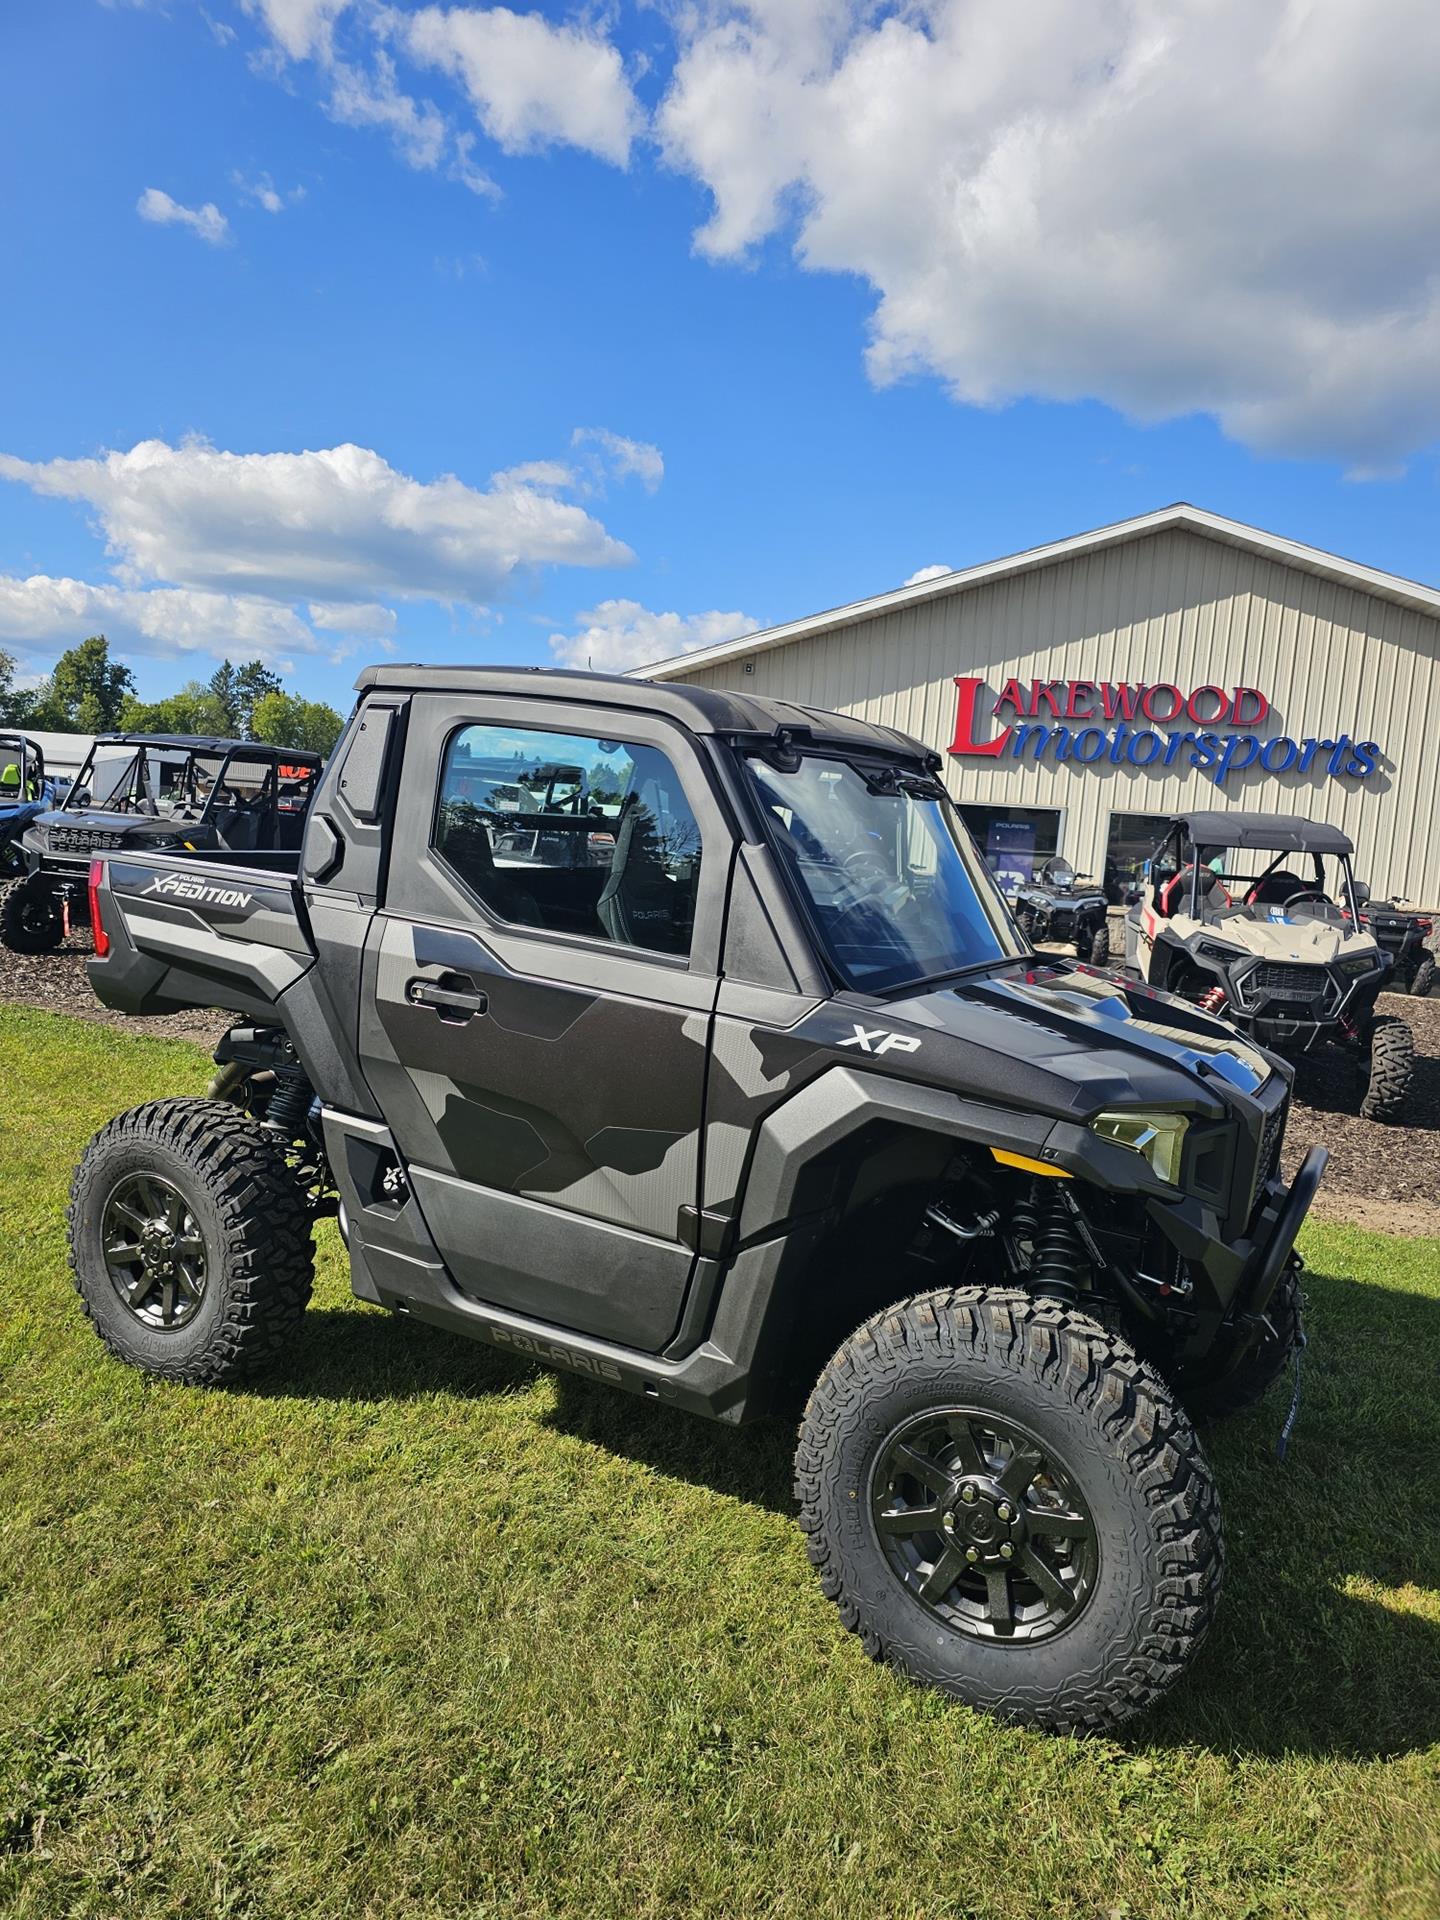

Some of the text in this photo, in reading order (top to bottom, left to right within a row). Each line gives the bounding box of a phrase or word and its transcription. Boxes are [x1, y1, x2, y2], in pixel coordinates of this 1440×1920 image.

[947, 677, 1269, 758] LAKEWOOD
[1012, 723, 1381, 785] motorsports
[58, 834, 111, 848] POLARIS
[995, 822, 1031, 830] POLARIS
[140, 873, 252, 908] XPEDITION
[179, 874, 206, 884] POLARIS
[835, 1024, 922, 1055] XP
[490, 1326, 622, 1381] POLARIS
